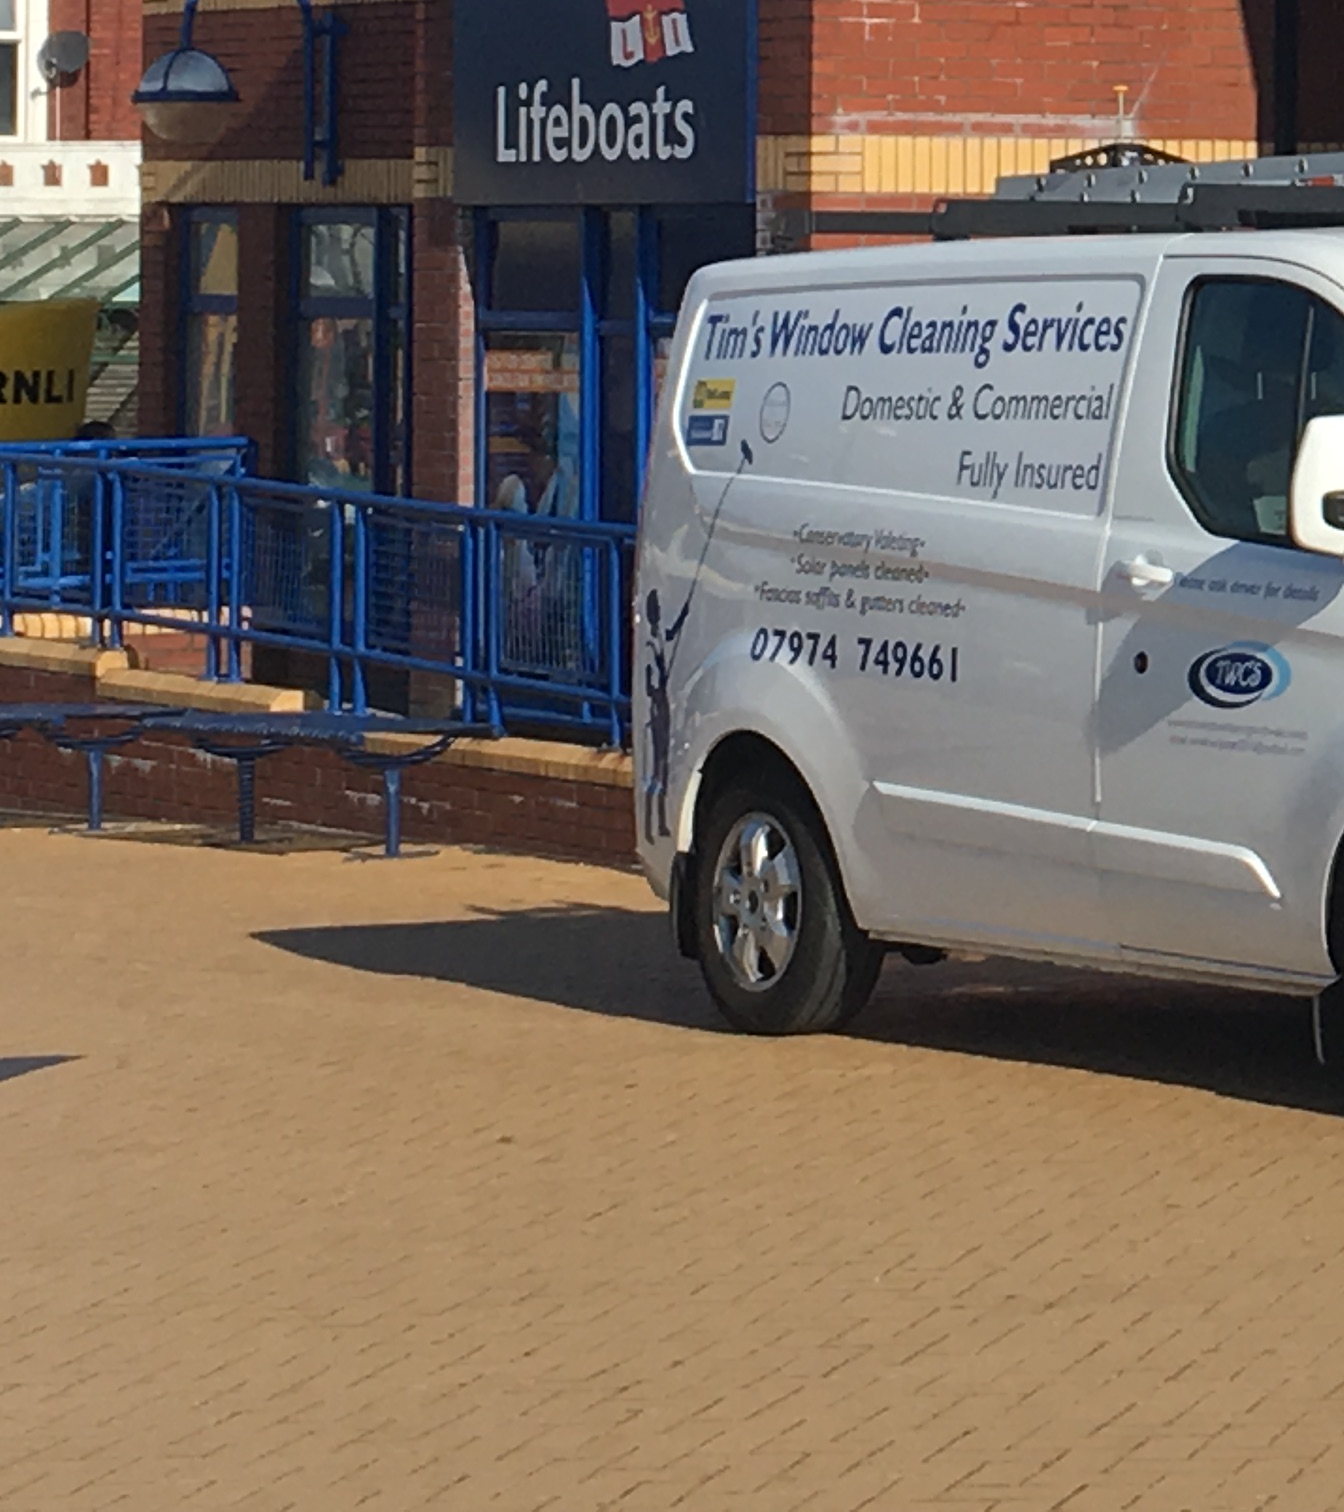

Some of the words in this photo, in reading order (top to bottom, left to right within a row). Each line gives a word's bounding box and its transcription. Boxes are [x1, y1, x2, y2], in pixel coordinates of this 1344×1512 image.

[496, 77, 695, 162] Lifeboats
[704, 309, 765, 361] Tim's
[768, 307, 873, 358] Window
[878, 304, 999, 369] Cleaning
[1002, 300, 1128, 353] Services
[841, 384, 941, 422] Domestic
[947, 384, 965, 422] &
[972, 382, 1115, 422] Commercial
[956, 450, 1009, 500] Fully
[1014, 451, 1103, 491] Insured
[845, 588, 855, 610] &
[750, 627, 838, 669] 07974
[857, 637, 959, 683] 749661
[1215, 659, 1262, 687] TWCS
